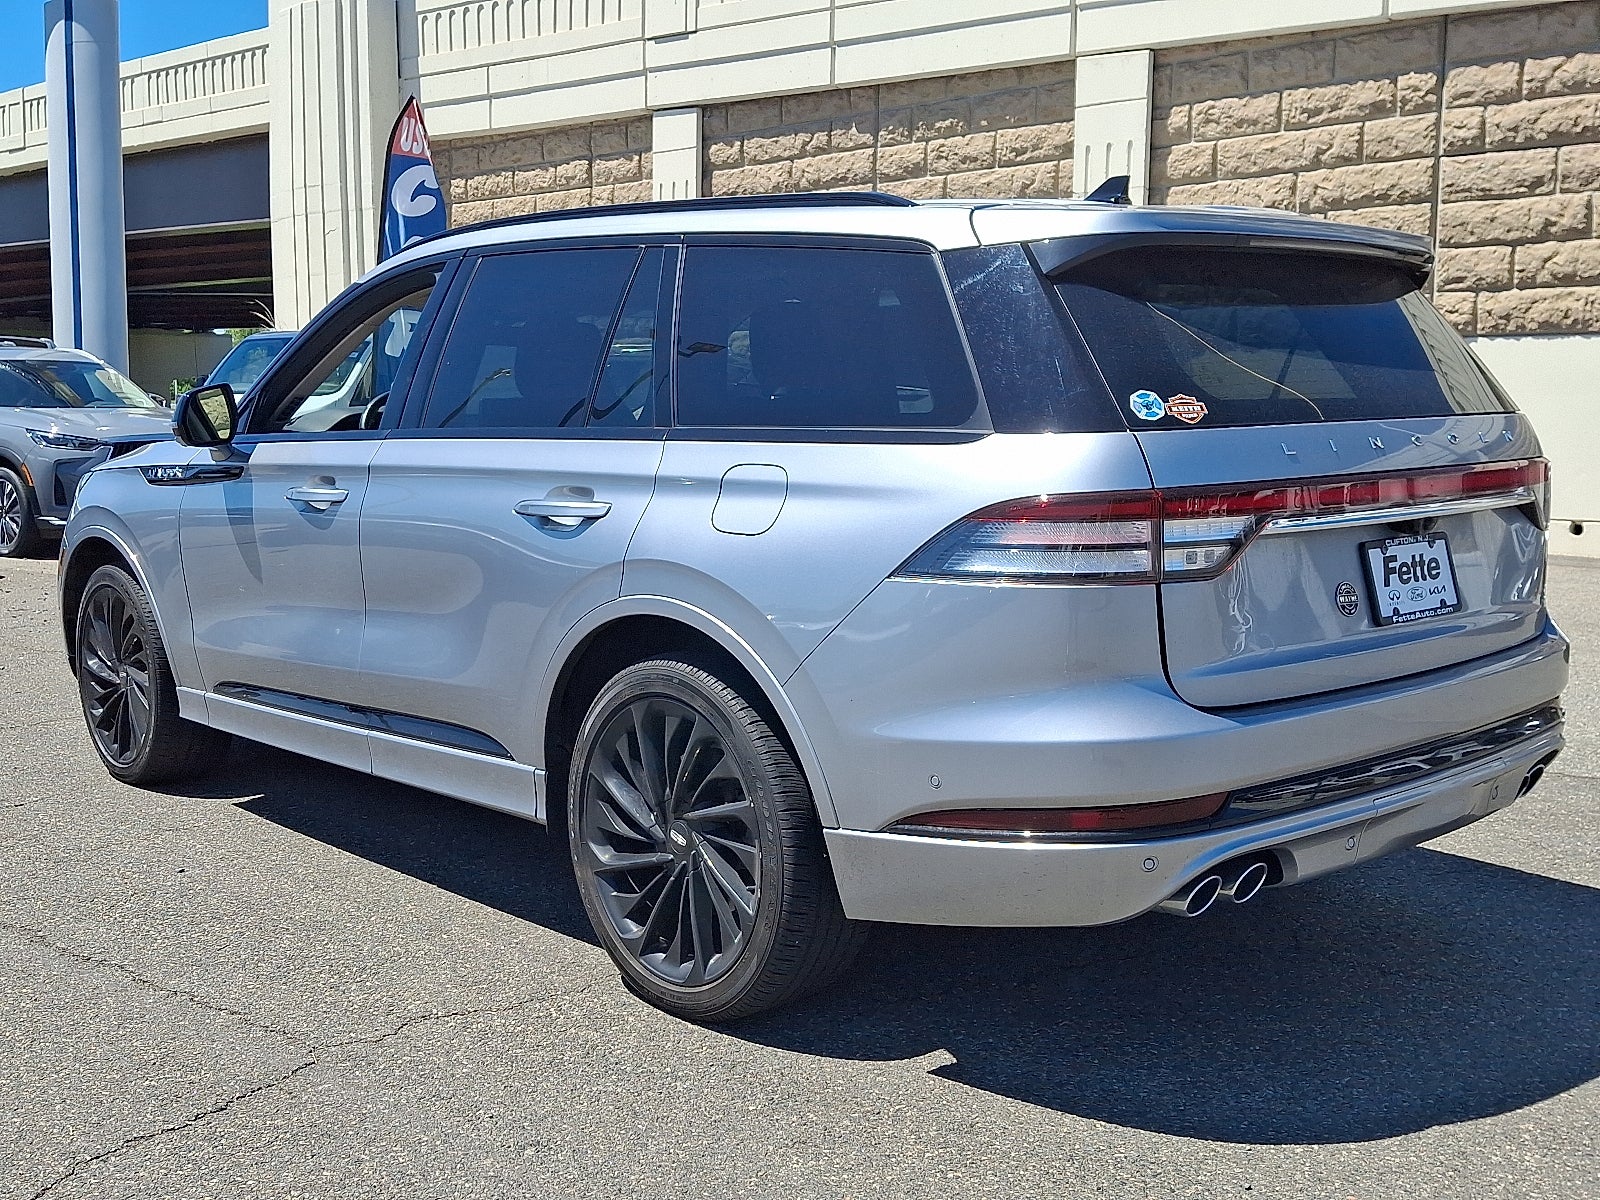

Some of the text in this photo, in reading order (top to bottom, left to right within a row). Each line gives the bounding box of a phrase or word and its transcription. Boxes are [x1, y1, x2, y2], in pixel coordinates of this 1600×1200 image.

[1281, 430, 1513, 455] LINCOLN
[1383, 553, 1440, 587] Fette
[1393, 607, 1453, 623] FetteAuto.com
